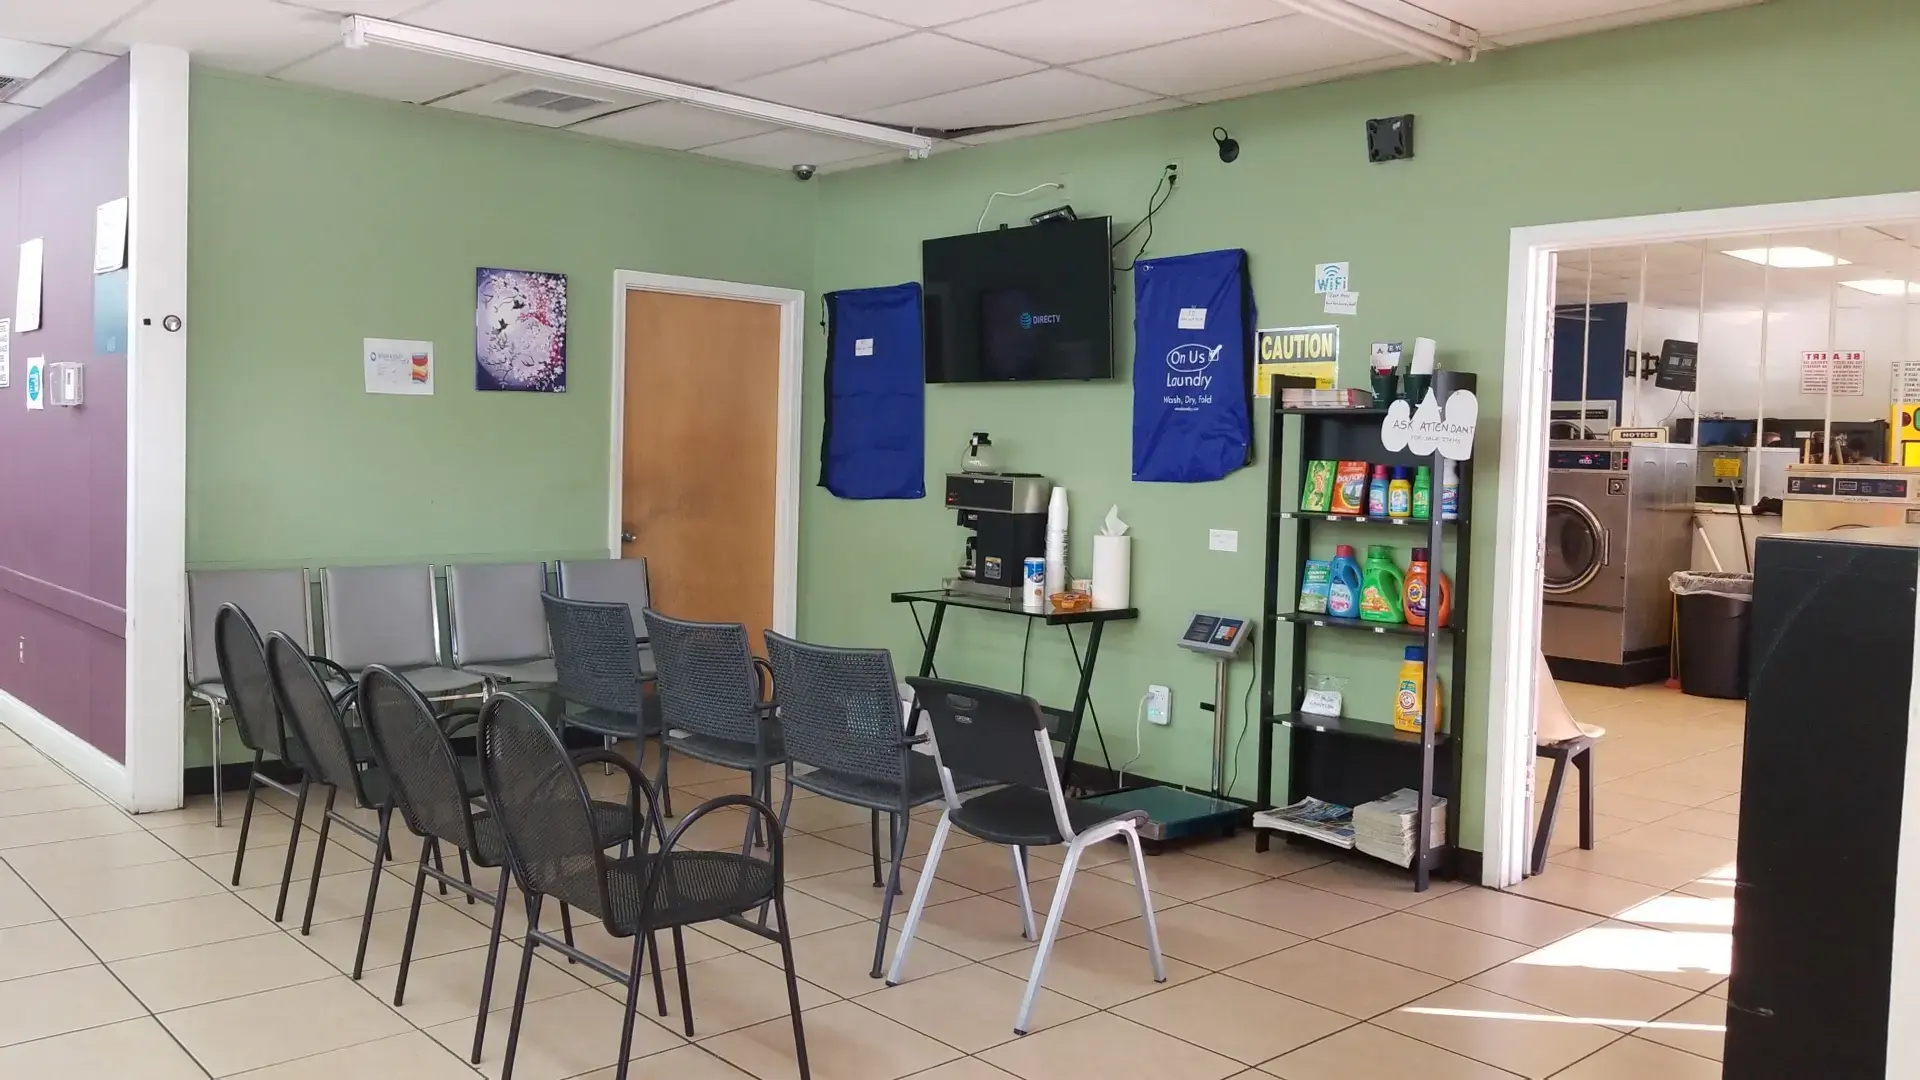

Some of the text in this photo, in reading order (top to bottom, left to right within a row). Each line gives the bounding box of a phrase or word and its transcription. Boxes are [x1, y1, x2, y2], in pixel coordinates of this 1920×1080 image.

[1032, 315, 1061, 324] DIRECTV
[1261, 333, 1333, 360] CAUTION
[1170, 350, 1206, 365] On Us
[1166, 371, 1212, 391] Laundry
[1163, 395, 1183, 405] Wash,
[1392, 420, 1414, 430] ASK
